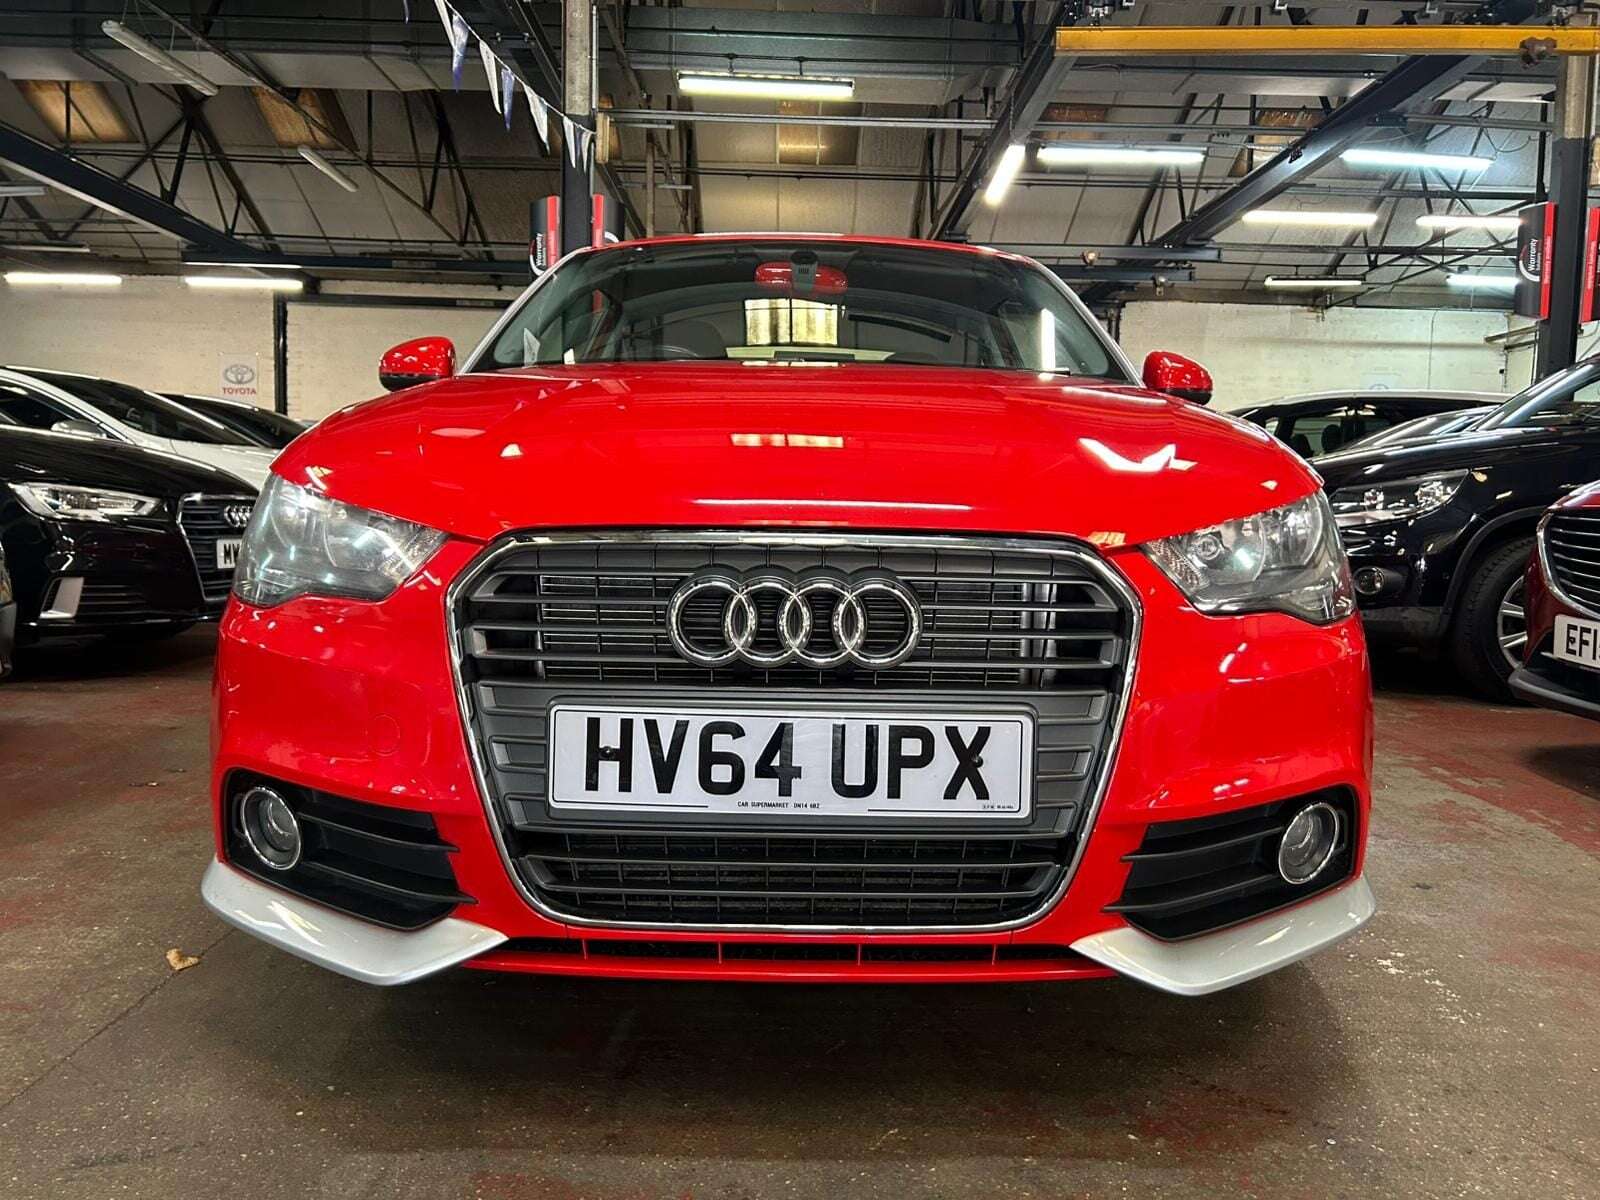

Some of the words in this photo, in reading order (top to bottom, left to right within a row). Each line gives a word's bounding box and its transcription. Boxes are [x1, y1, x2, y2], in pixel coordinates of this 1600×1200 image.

[535, 232, 545, 267] Warranty
[1528, 238, 1539, 272] Warranty
[222, 387, 257, 395] TOYOTA
[1565, 623, 1600, 661] EF1
[585, 717, 802, 797] HV64
[831, 724, 991, 801] UPX
